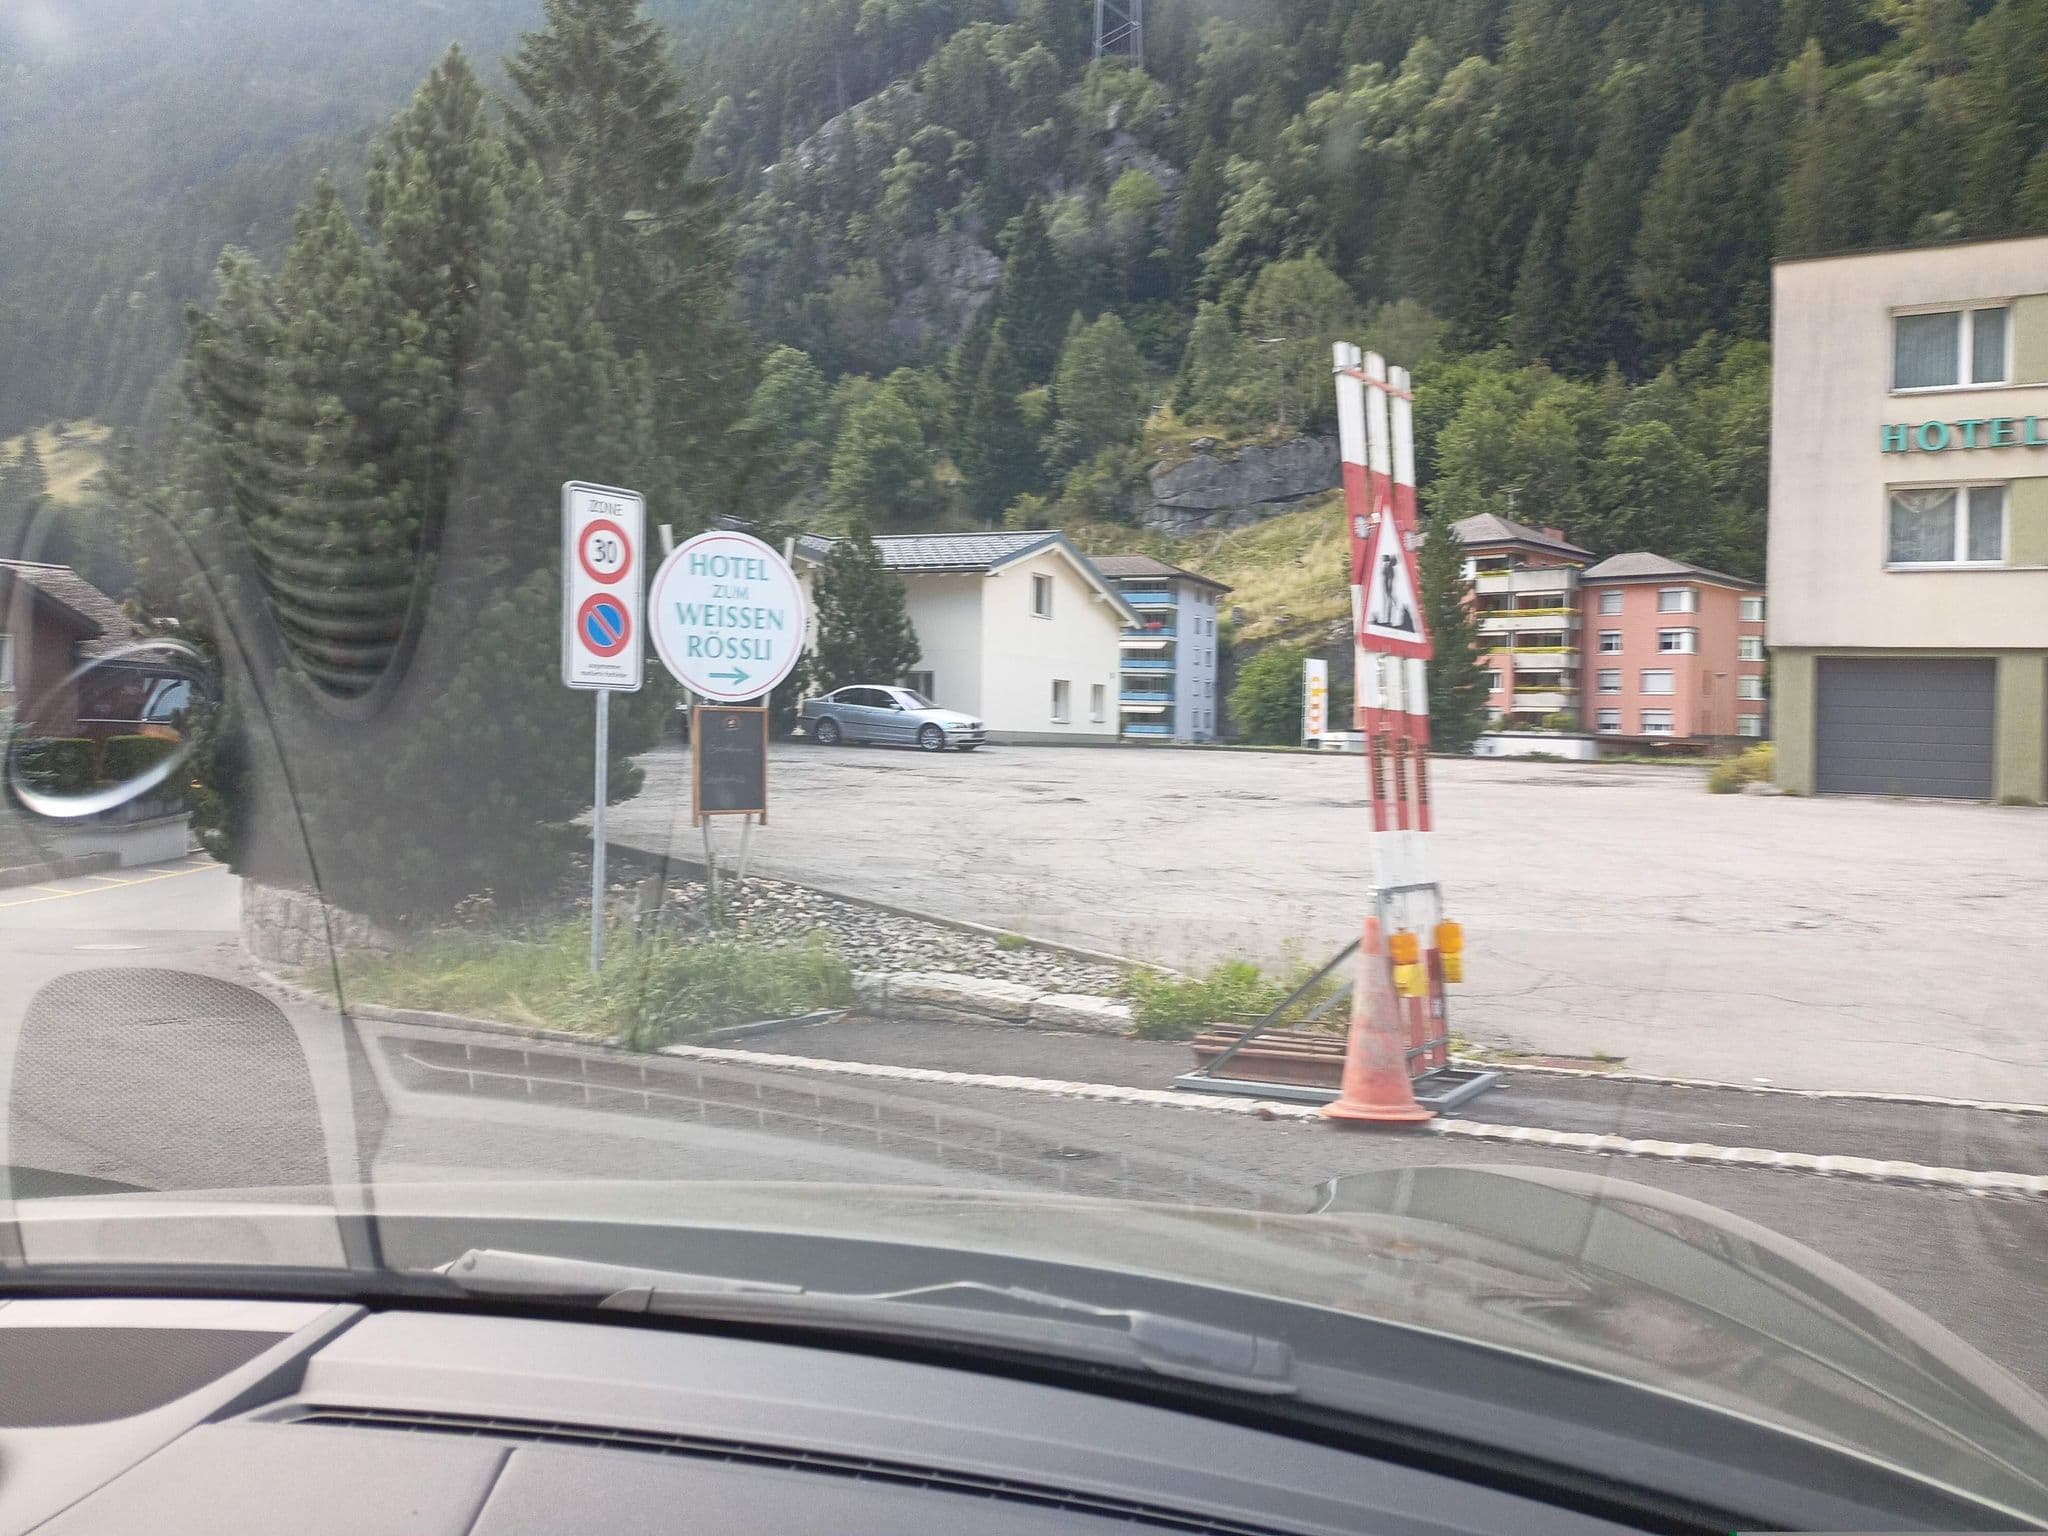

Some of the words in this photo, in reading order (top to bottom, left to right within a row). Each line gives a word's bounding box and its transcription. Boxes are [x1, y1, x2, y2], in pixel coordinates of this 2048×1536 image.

[1880, 416, 2048, 453] HOTEL
[587, 499, 624, 516] ZONE
[592, 538, 617, 564] 30
[689, 553, 770, 582] HOTEL
[712, 584, 749, 600] ZUM
[674, 602, 785, 631] WEISSEN
[687, 631, 773, 661] RÖSSLI
